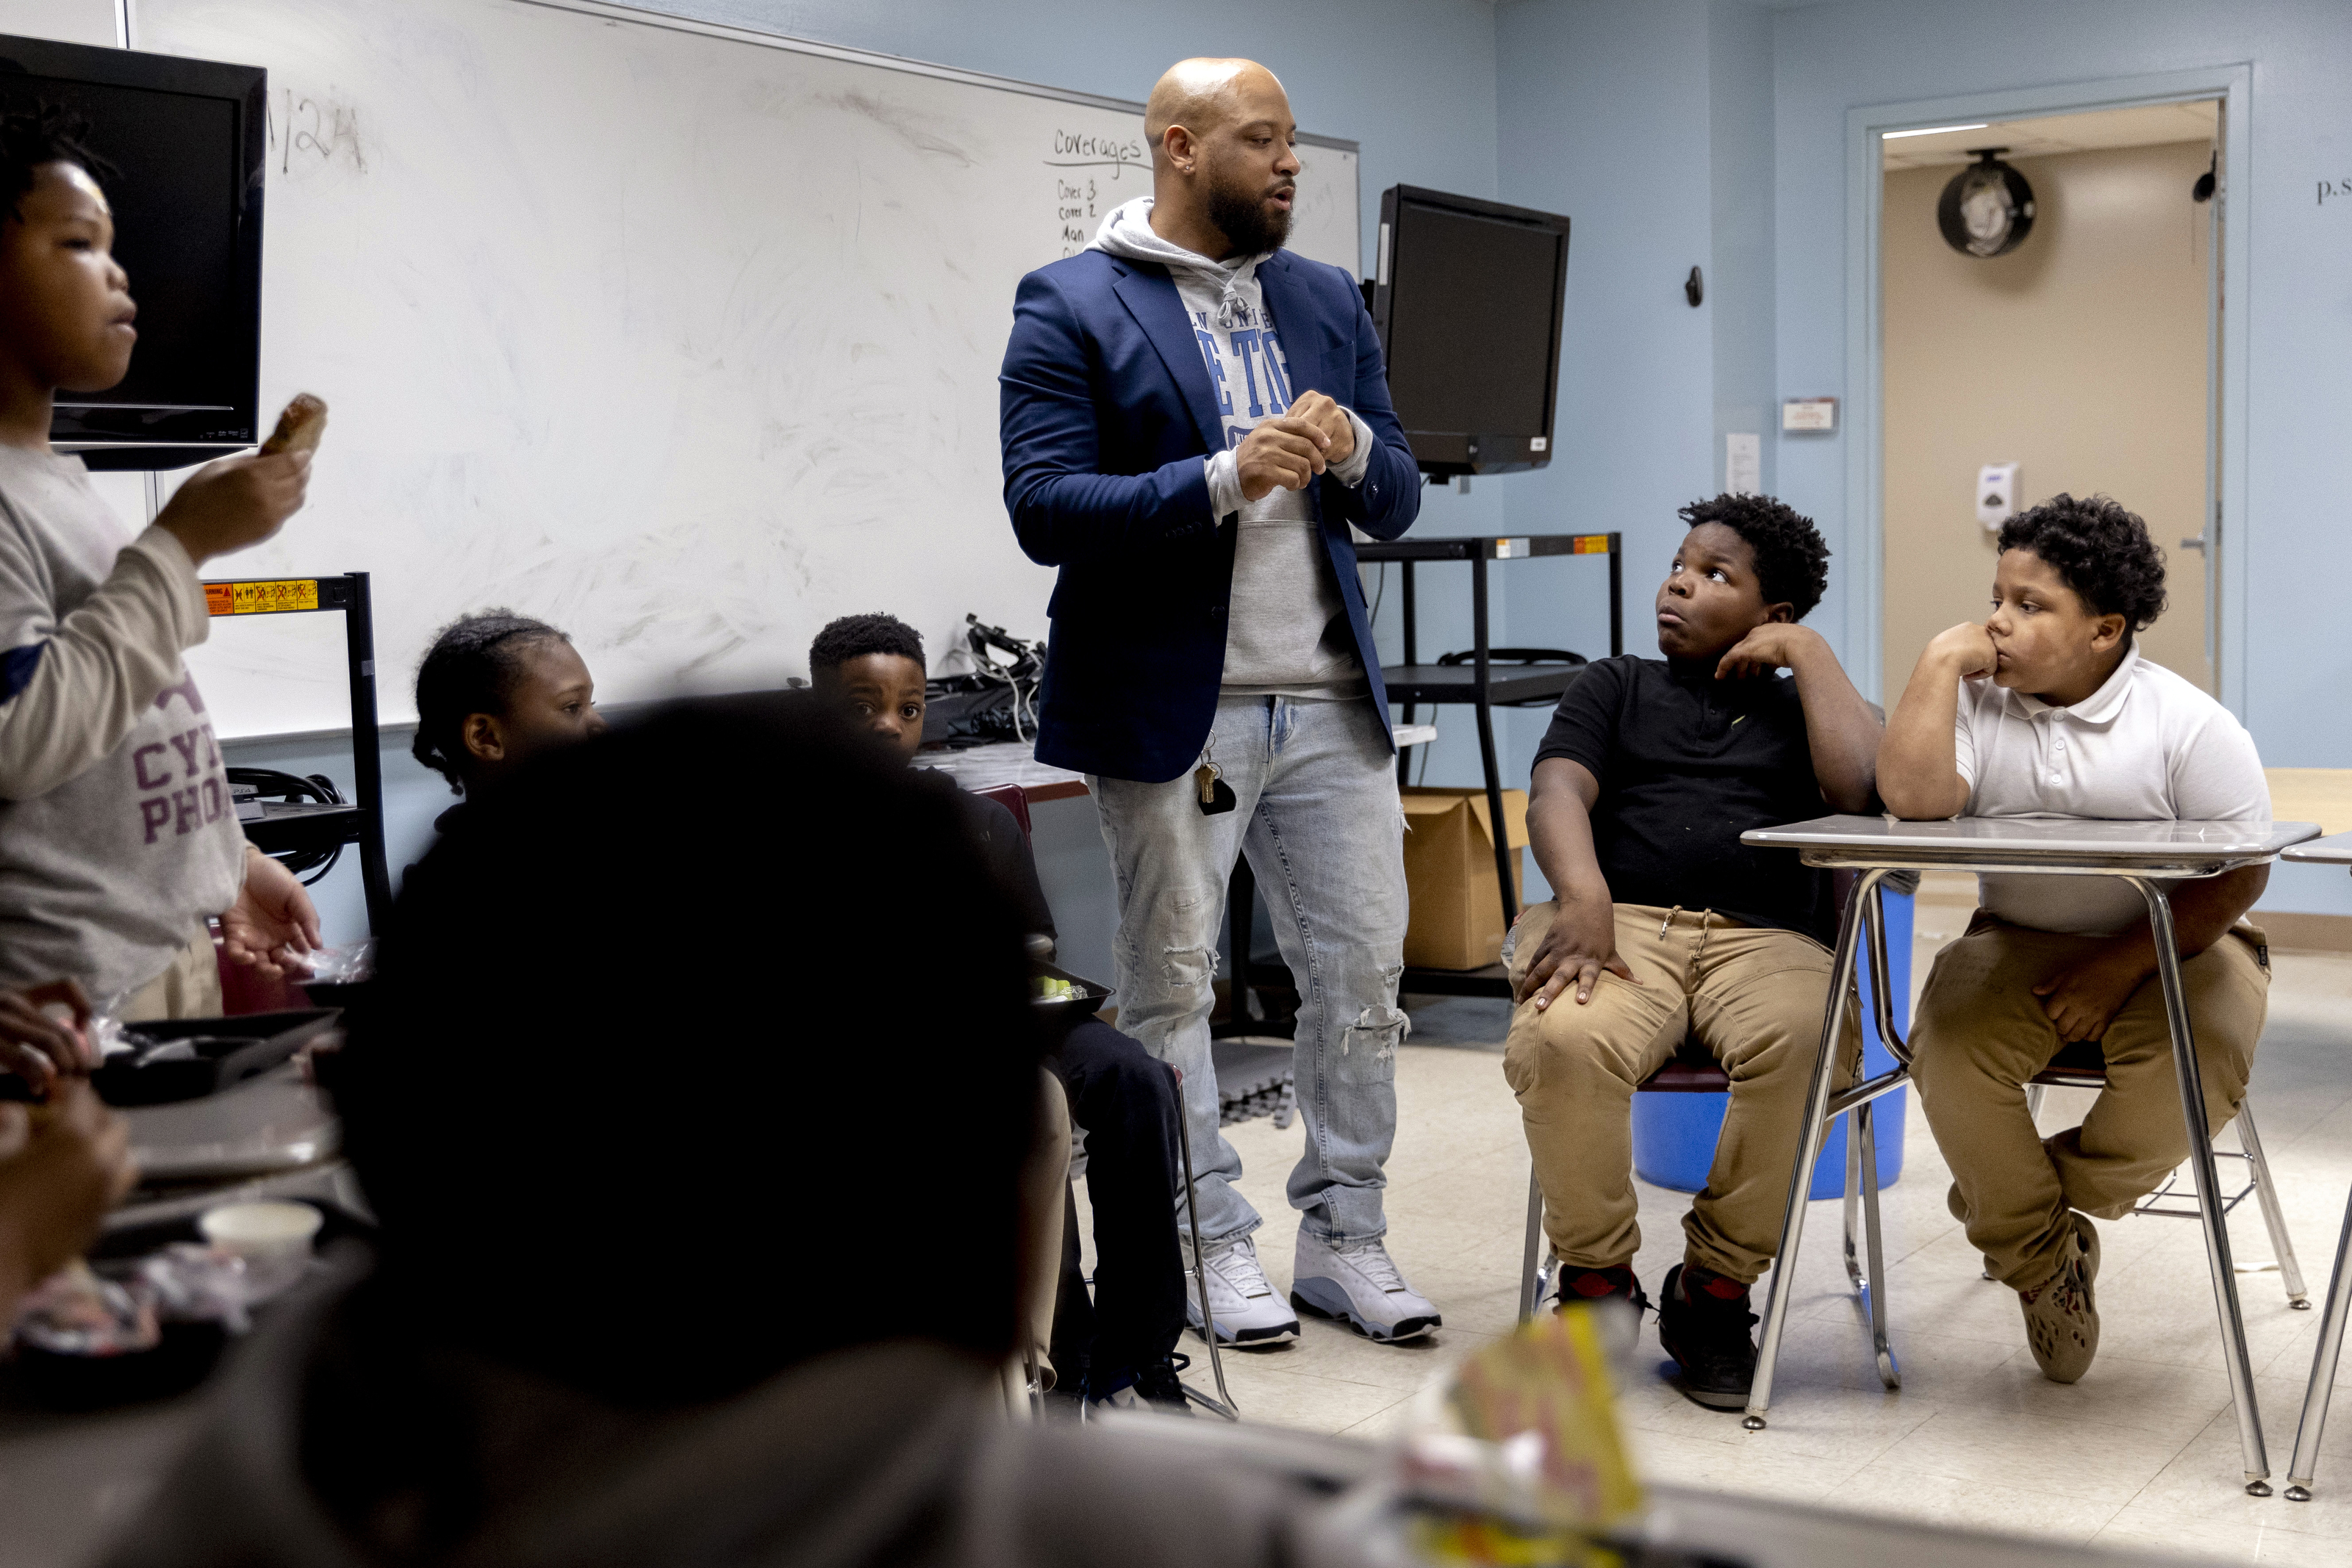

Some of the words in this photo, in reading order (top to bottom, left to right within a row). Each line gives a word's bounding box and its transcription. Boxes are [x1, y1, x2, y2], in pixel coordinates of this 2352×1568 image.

[1054, 129, 1141, 180] Coverages
[1057, 179, 1081, 201] Cover
[1086, 179, 1097, 201] 3
[1089, 204, 1097, 218] 2
[1061, 225, 1085, 243] Man
